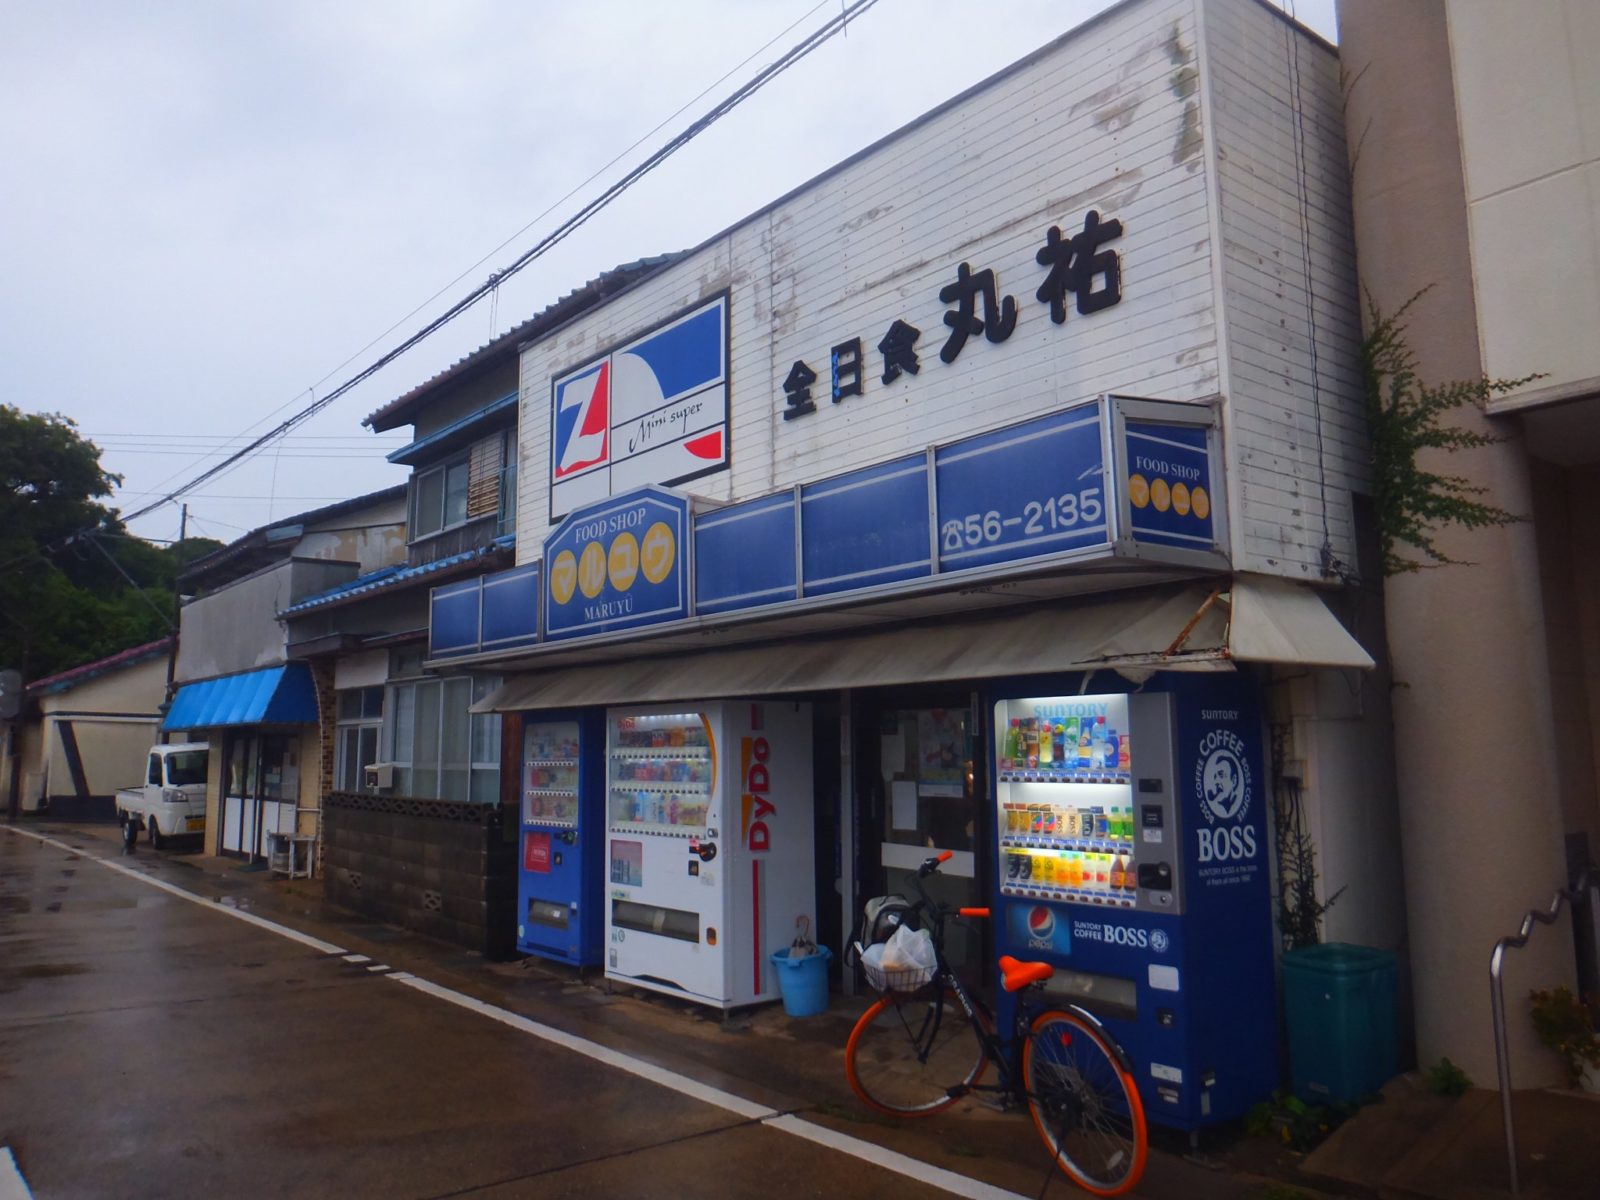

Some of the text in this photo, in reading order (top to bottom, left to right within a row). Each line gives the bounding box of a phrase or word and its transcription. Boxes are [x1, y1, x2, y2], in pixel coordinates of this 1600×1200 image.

[783, 209, 1124, 421] 全日食 丸祐
[629, 402, 703, 453] Mini super
[1136, 455, 1201, 481] FOOD SHOP
[575, 507, 647, 543] FOOD SHOP
[965, 487, 1101, 546] 56-2135
[552, 528, 671, 597] マルユウ
[1201, 709, 1239, 720] SUNTORY
[1199, 729, 1245, 757] COFFEE
[1197, 825, 1257, 862] BOSS
[1073, 928, 1102, 941] COFFEE
[1103, 924, 1148, 948] BOSS
